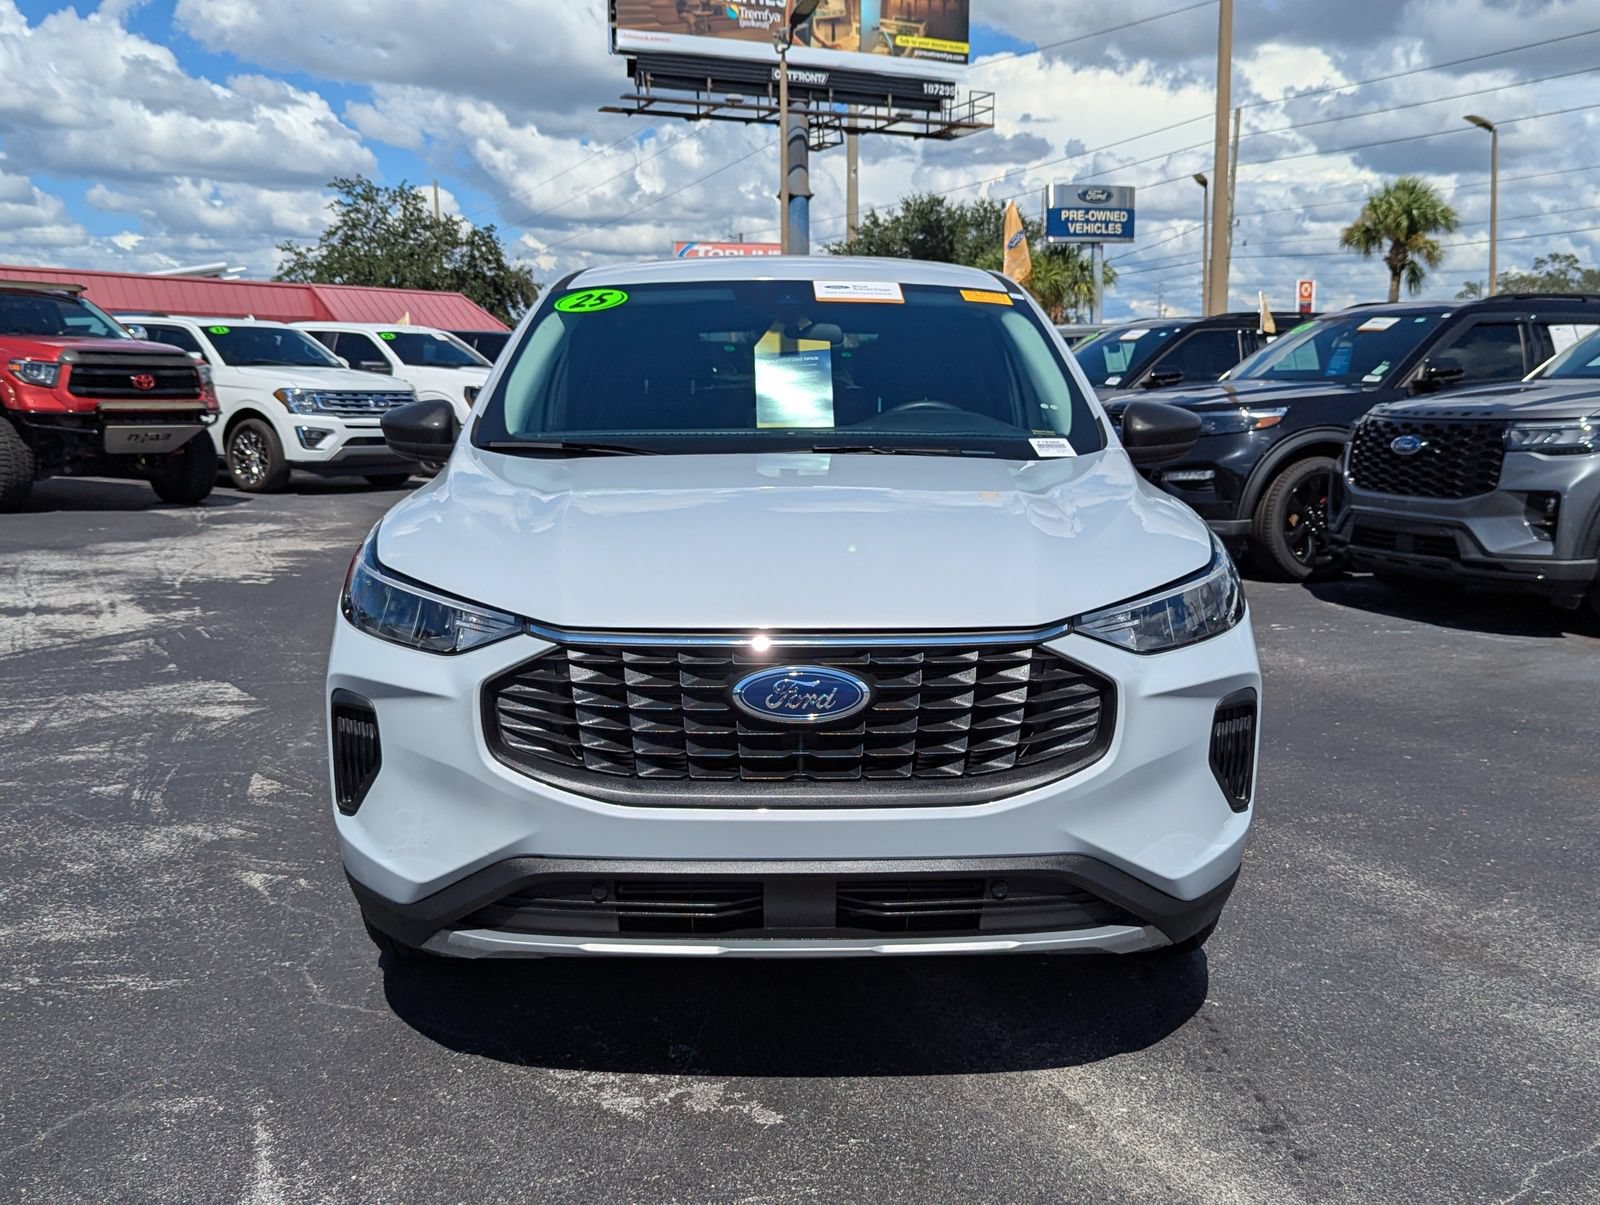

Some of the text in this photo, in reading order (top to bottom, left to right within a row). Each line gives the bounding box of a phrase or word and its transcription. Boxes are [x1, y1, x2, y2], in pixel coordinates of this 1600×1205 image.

[739, 6, 781, 24] Tremfya
[1061, 209, 1128, 222] PRE-OWNED
[1068, 222, 1122, 235] VEHICLES
[568, 292, 614, 309] 25
[765, 678, 839, 709] Ford
